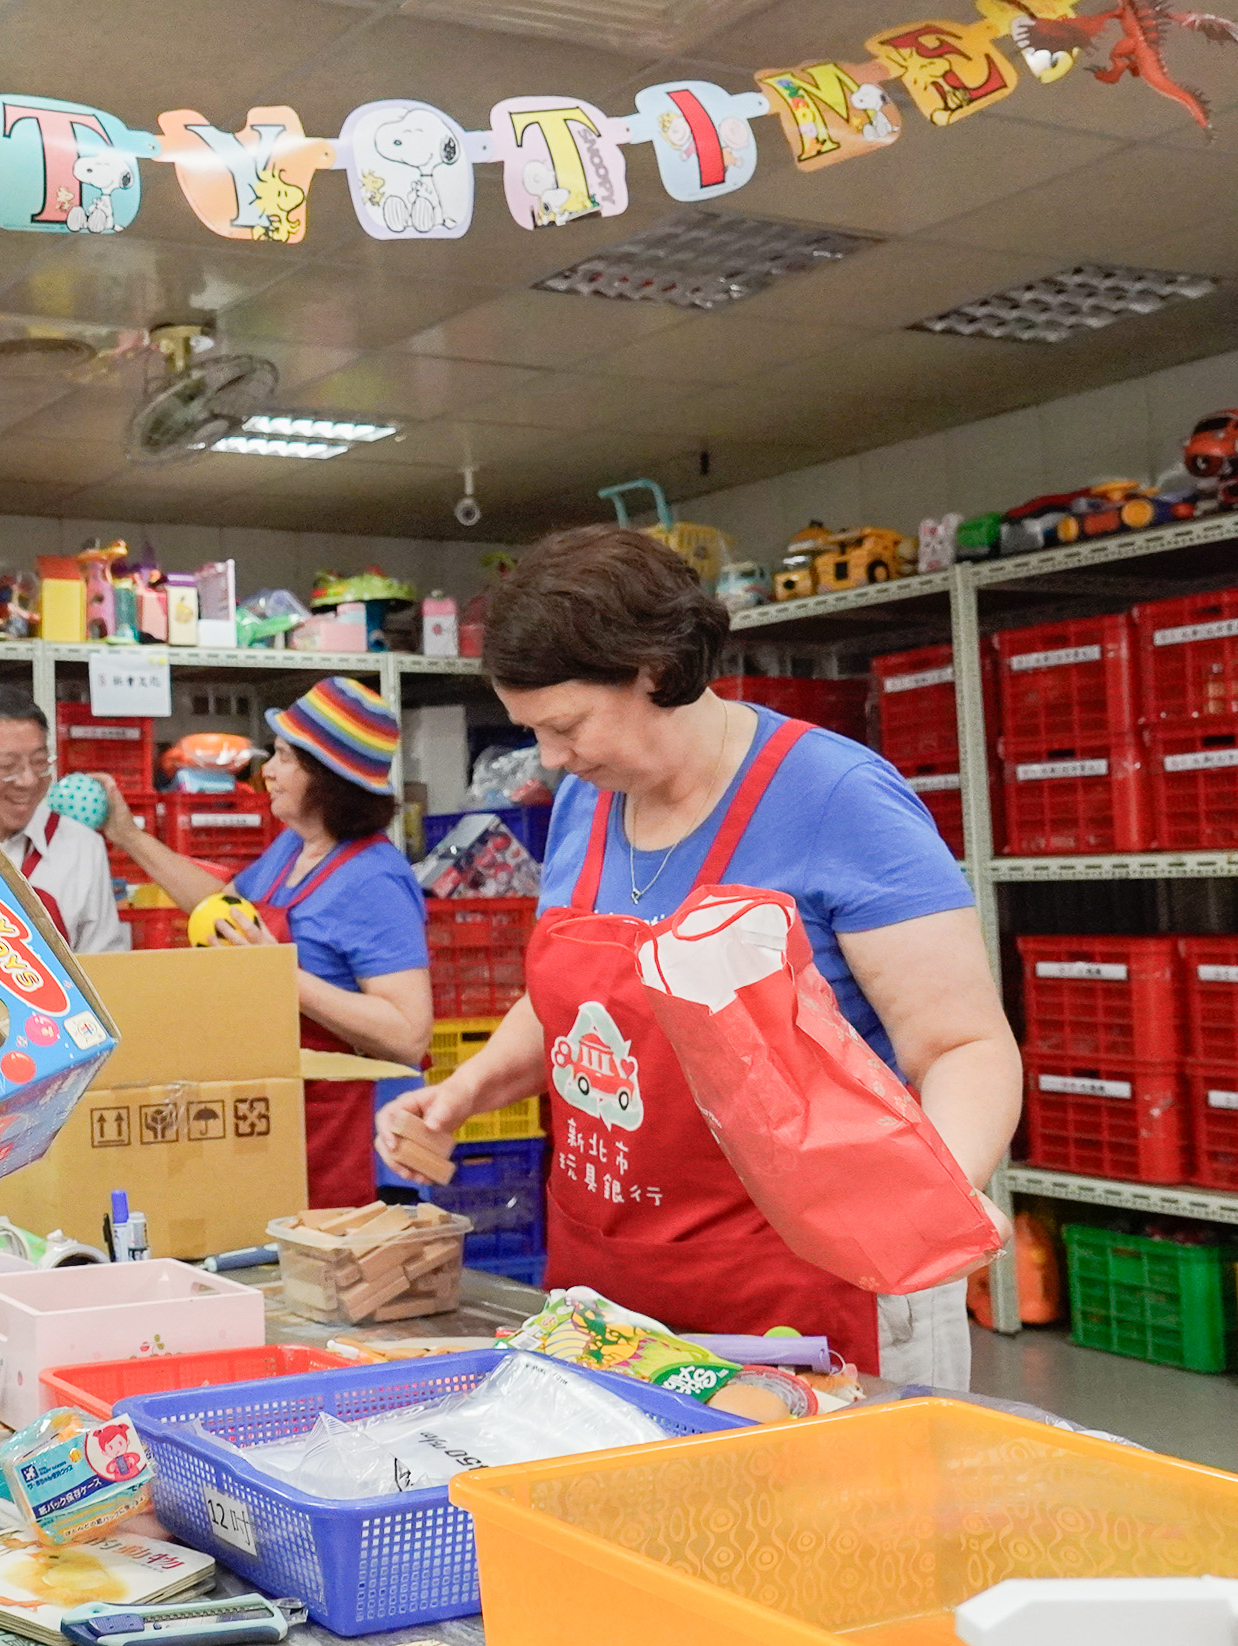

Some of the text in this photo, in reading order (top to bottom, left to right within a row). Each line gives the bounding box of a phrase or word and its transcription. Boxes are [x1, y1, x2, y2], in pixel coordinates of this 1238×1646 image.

[567, 1117, 629, 1175] 新北市
[559, 1152, 663, 1206] 玩具銀行
[37, 1477, 102, 1515] 紙パック保存ケース
